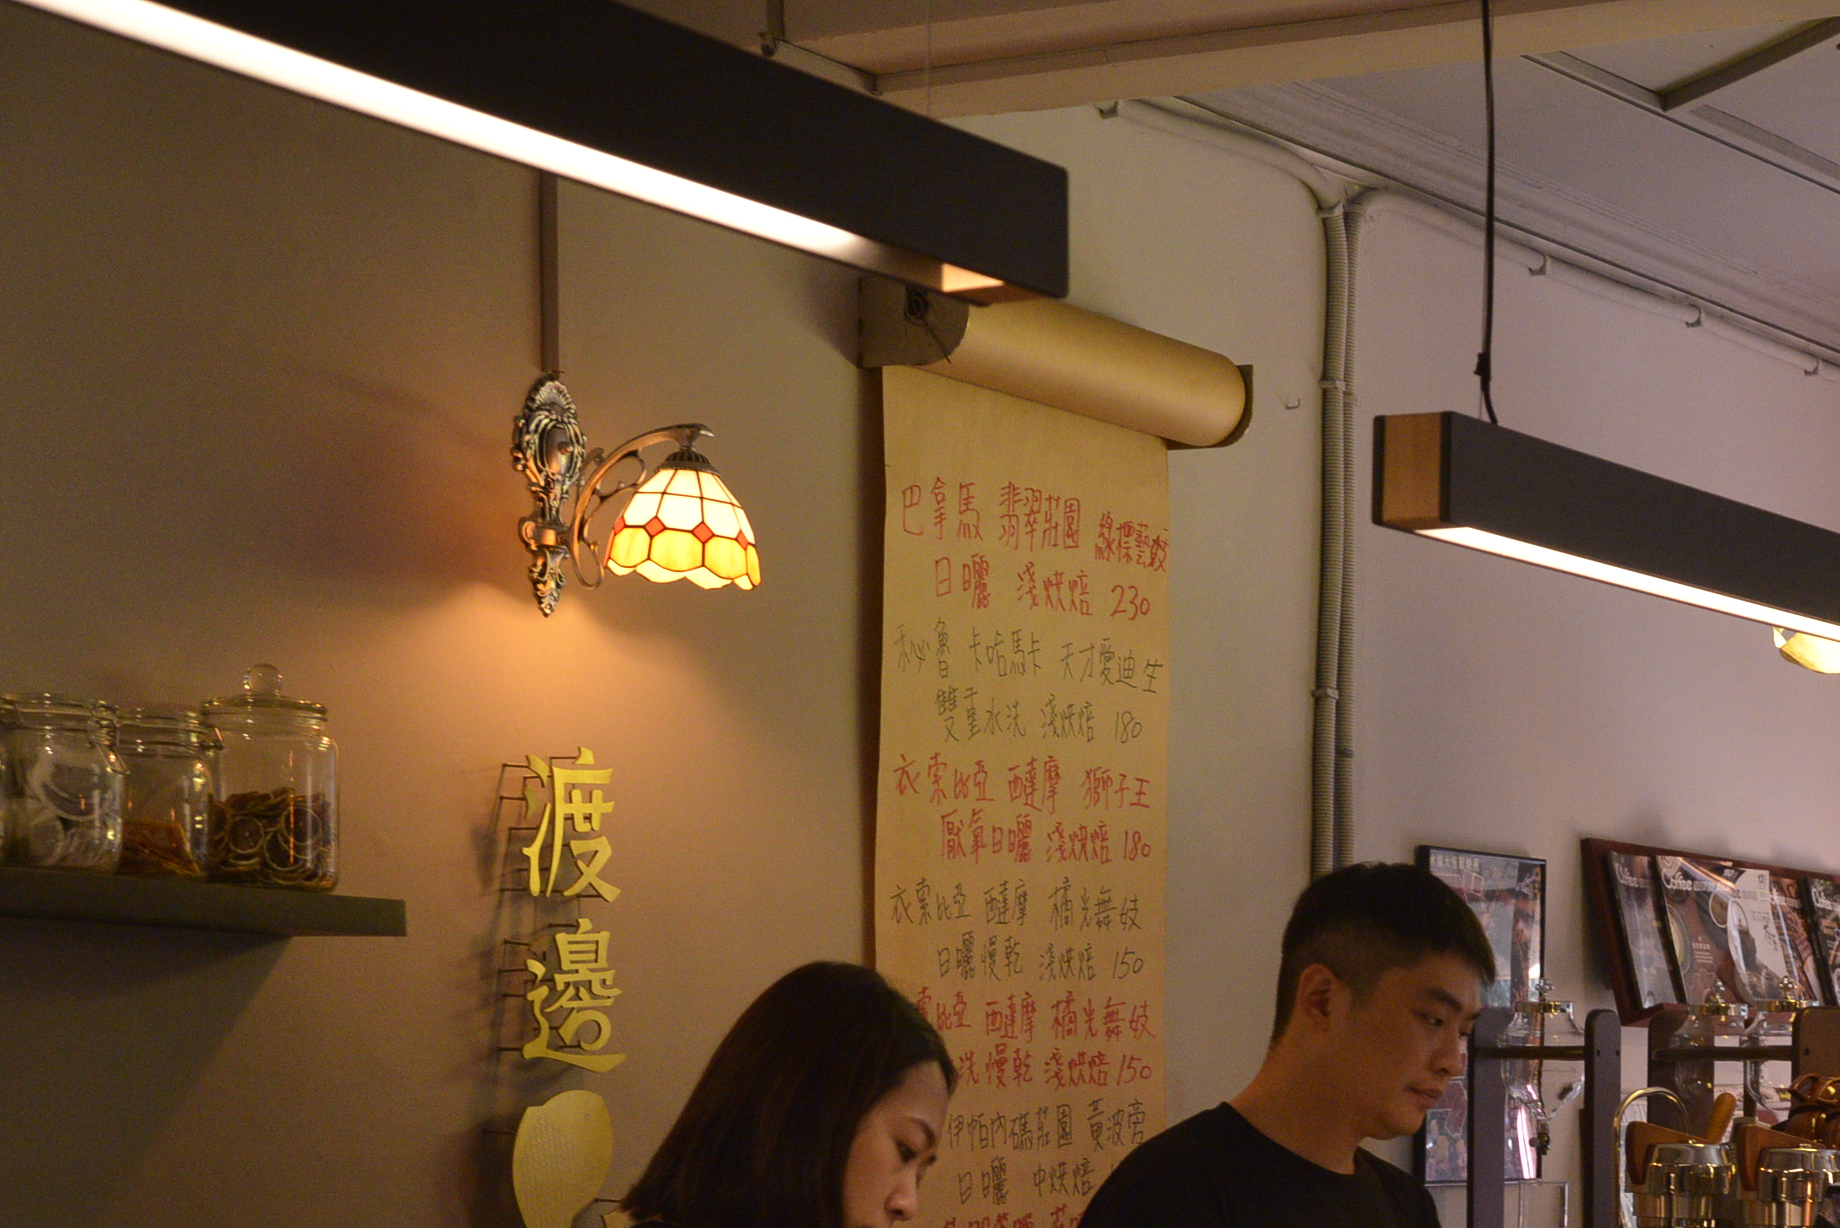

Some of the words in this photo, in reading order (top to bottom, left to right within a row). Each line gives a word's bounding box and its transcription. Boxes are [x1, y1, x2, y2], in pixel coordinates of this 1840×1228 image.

[901, 475, 984, 541] 巴拿馬
[999, 480, 1081, 552] 翡翠莊園
[934, 552, 991, 610] 日曬
[1016, 560, 1093, 617] 淺烘焙
[1110, 584, 1152, 621] 230
[935, 685, 1027, 743] 雙重水洗
[1114, 710, 1143, 744] 180
[1080, 764, 1150, 810] 獅子王
[1122, 829, 1152, 862] 180
[521, 746, 627, 1073] 渡邊
[1112, 946, 1145, 980] 150
[916, 986, 972, 1032] 索比亞
[955, 1042, 1034, 1089] 洗慢乾
[1115, 1053, 1153, 1086] 150
[957, 1156, 1010, 1206] 日曬
